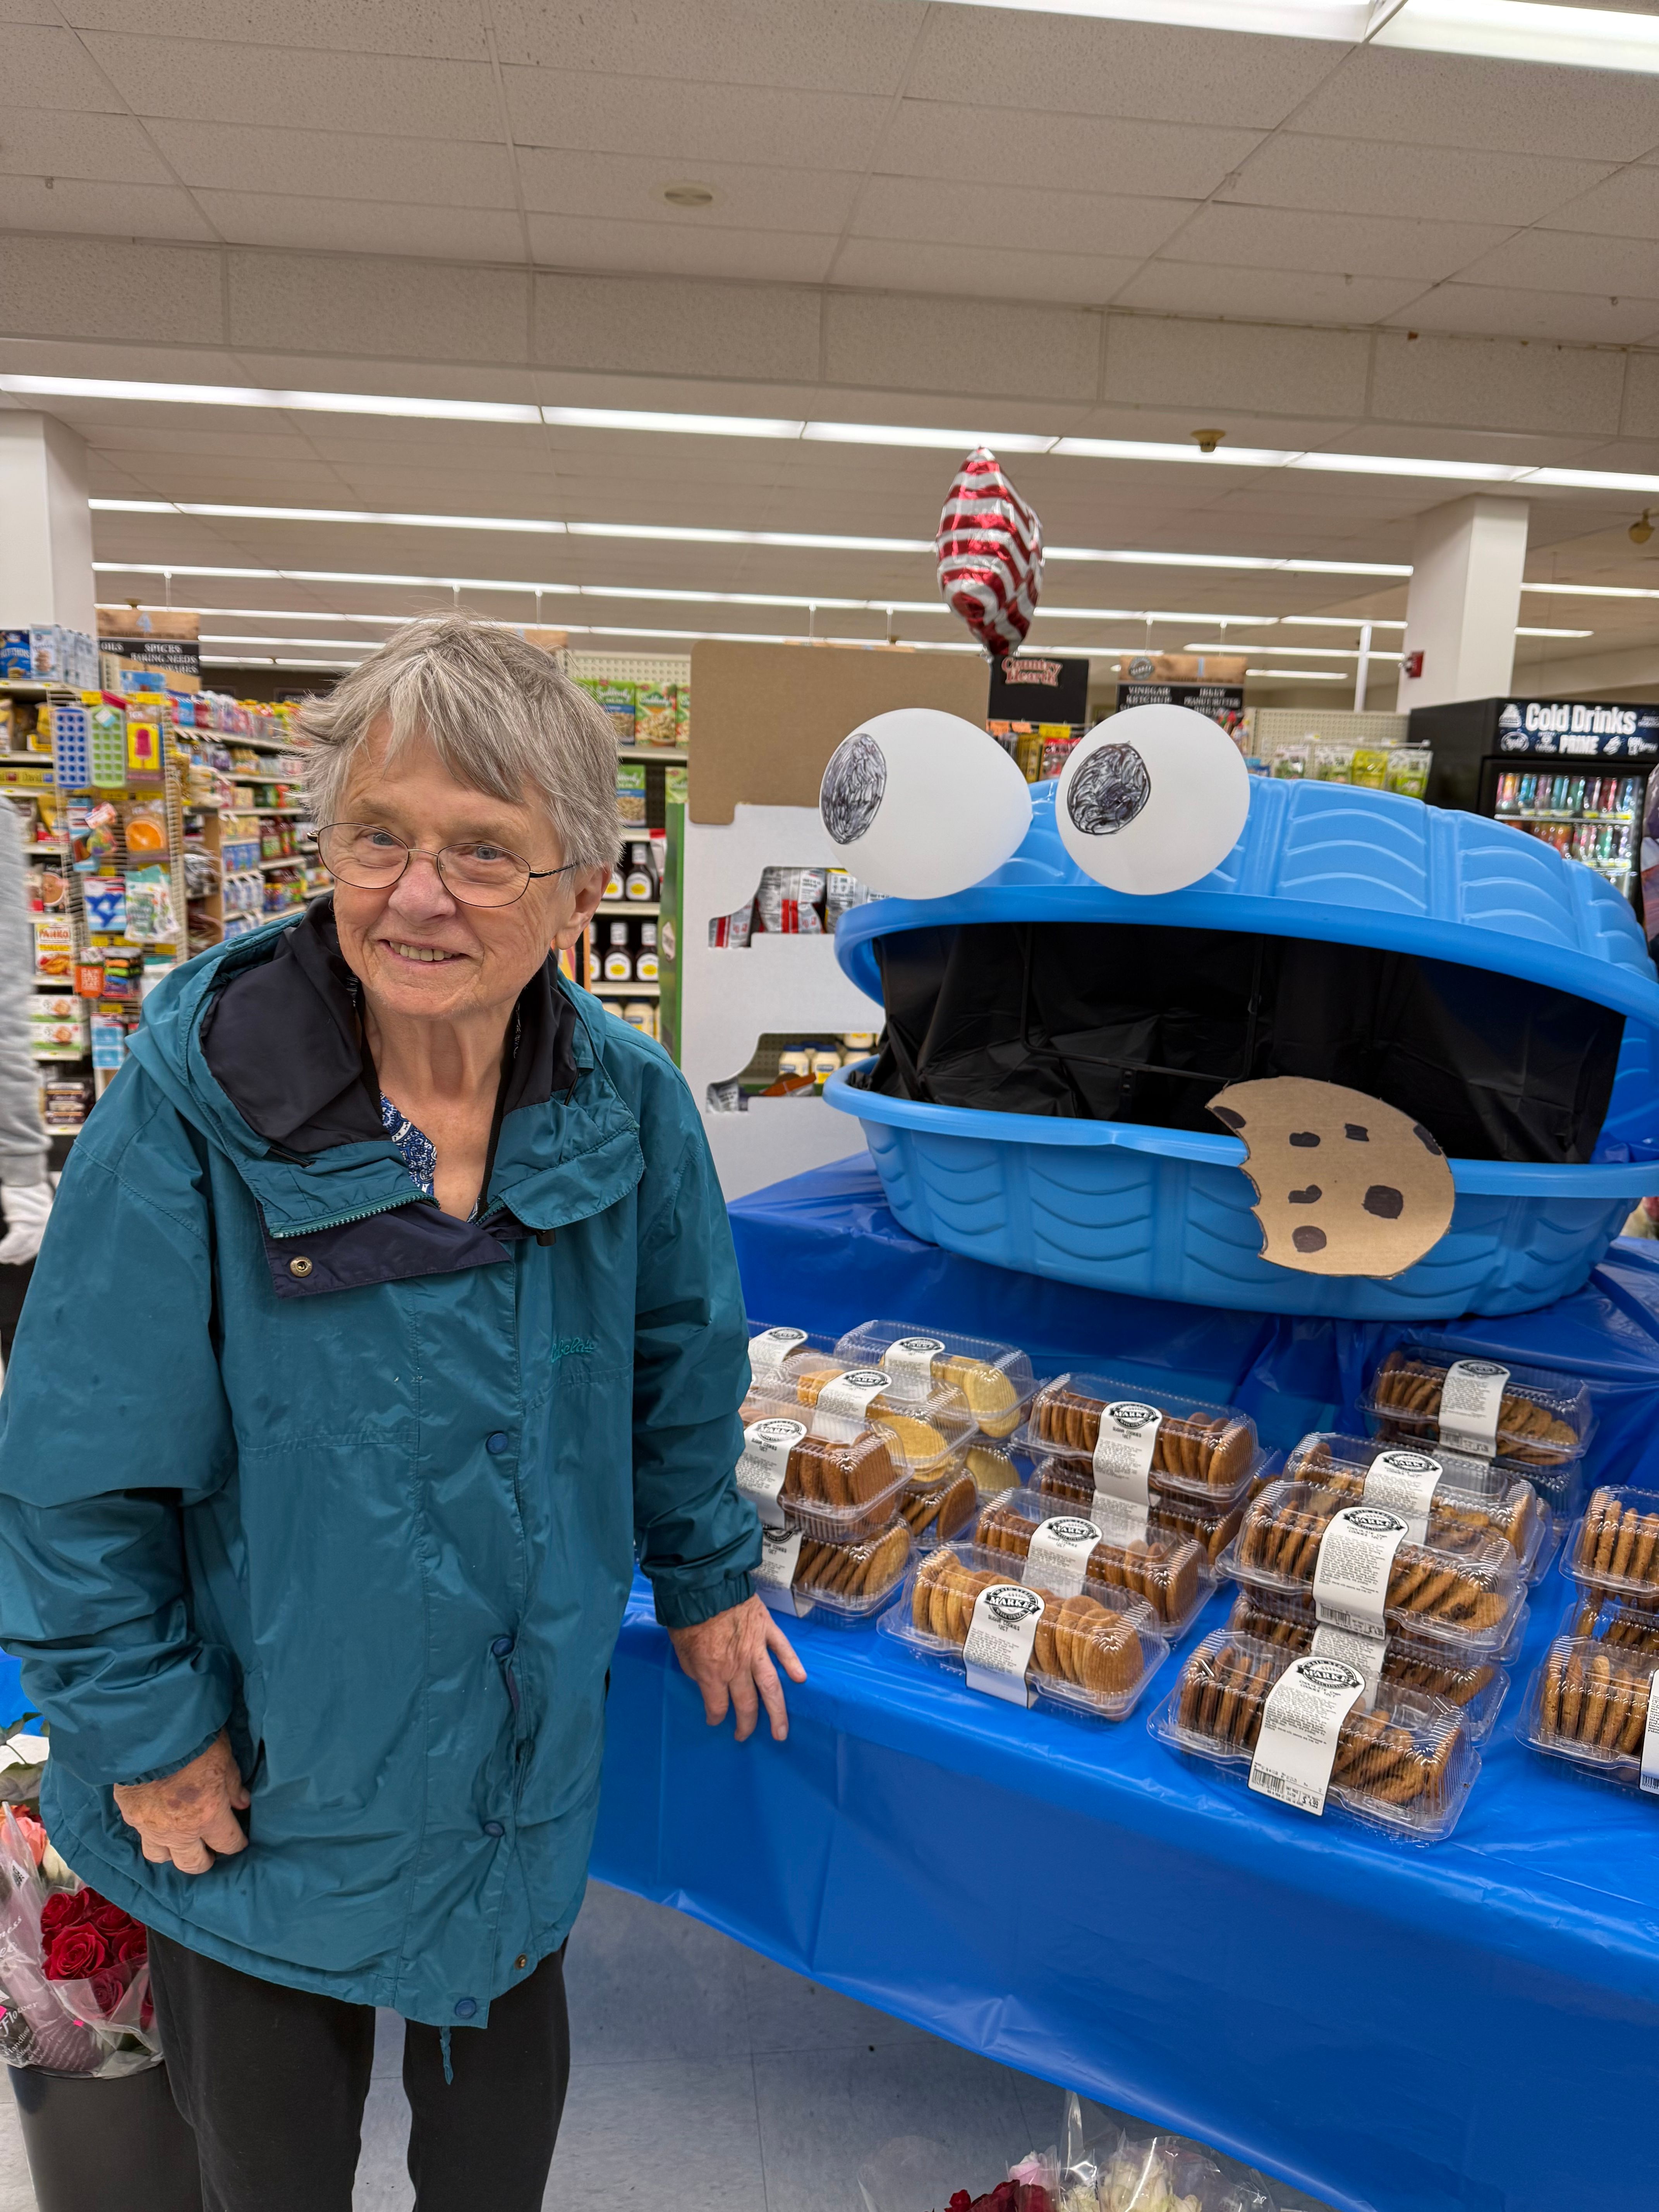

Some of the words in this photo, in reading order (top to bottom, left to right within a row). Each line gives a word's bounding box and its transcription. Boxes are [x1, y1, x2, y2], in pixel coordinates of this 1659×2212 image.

[136, 612, 151, 632] 4
[101, 641, 124, 652] OILS
[144, 643, 183, 654] SPICES
[167, 654, 199, 665] NEEDS
[1001, 657, 1063, 678] Country
[1005, 668, 1058, 687] Hearth
[1128, 686, 1171, 696] VINEGAR
[1200, 687, 1227, 697] JELLY
[1126, 695, 1172, 704] KETCHUP
[1184, 696, 1211, 706] PEANUT
[1211, 697, 1241, 708] BUTTER
[1526, 702, 1571, 732] Cold
[1571, 704, 1637, 735] Drinks
[1559, 735, 1600, 755] PRIME
[1114, 1411, 1154, 1420] MARKET
[1350, 1516, 1398, 1529] MARKET
[1053, 1525, 1094, 1537] MARKET
[989, 1596, 1036, 1610] MARKET
[988, 1614, 1001, 1624] SUGAR
[1003, 1621, 1020, 1632] COOKIES
[1303, 1669, 1354, 1685] MARKET
[1308, 1798, 1319, 1809] 4.99
